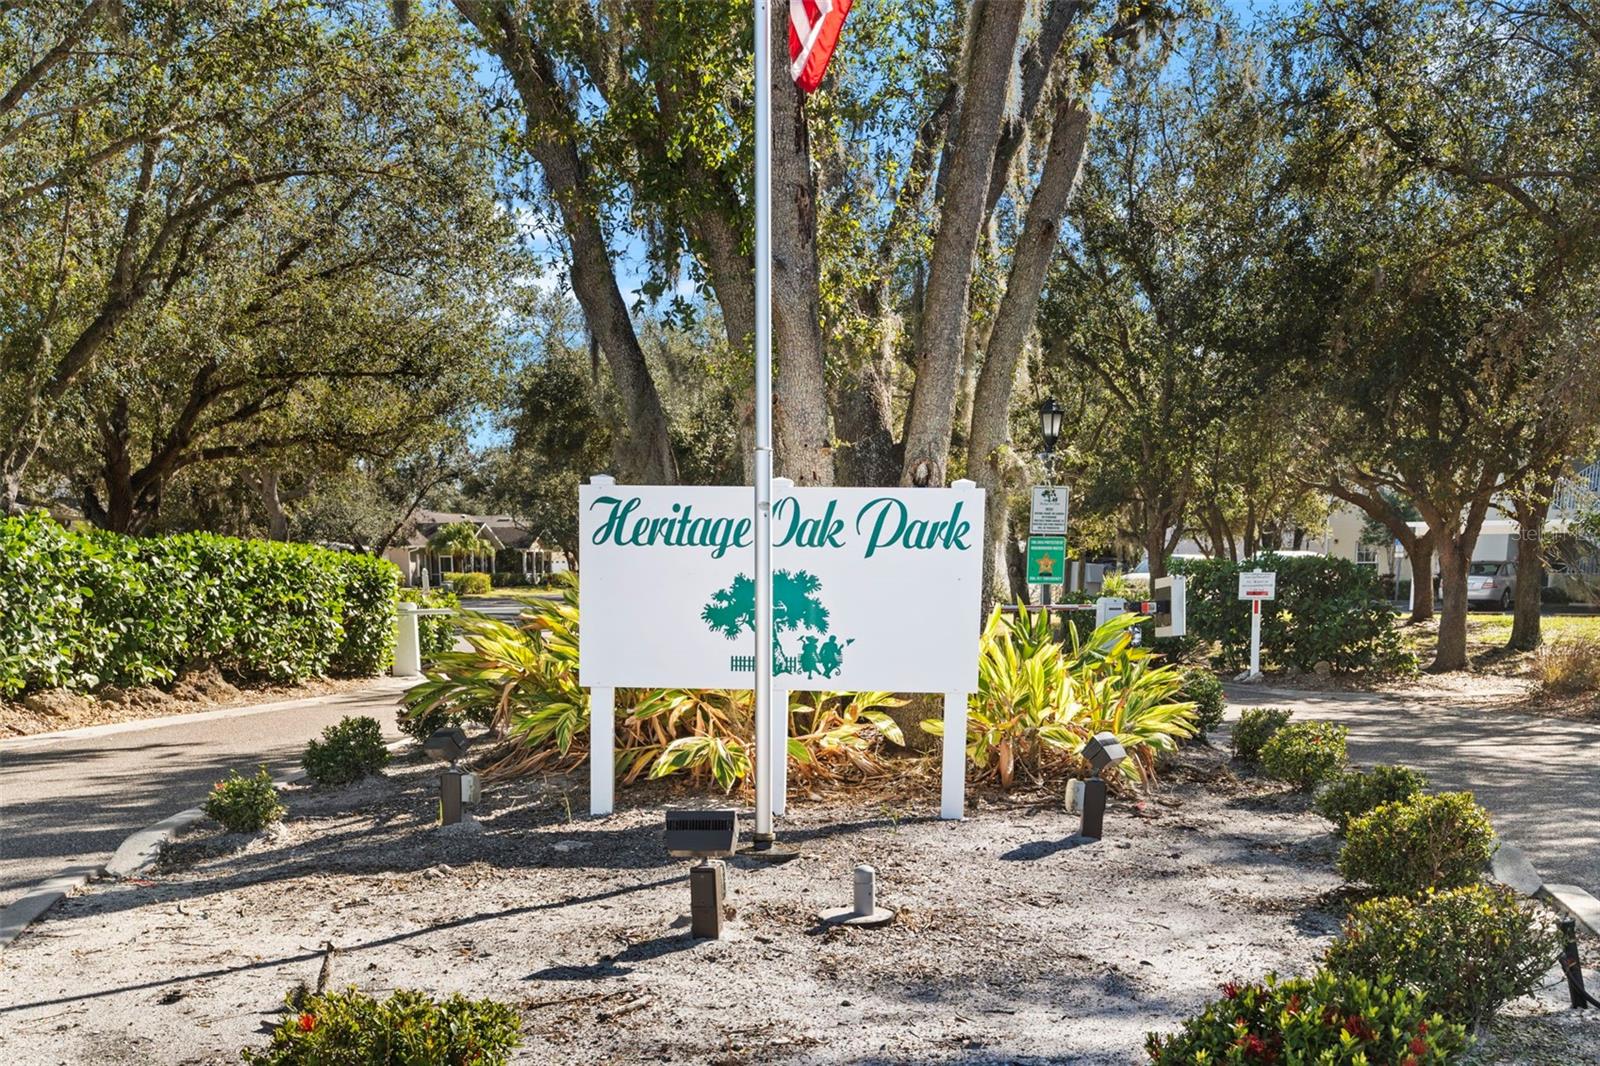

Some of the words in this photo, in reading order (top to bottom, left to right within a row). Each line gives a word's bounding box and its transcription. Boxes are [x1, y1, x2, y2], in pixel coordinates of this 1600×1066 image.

[590, 495, 753, 559] Heritage
[771, 496, 846, 548] Oak
[855, 495, 972, 558] Park
